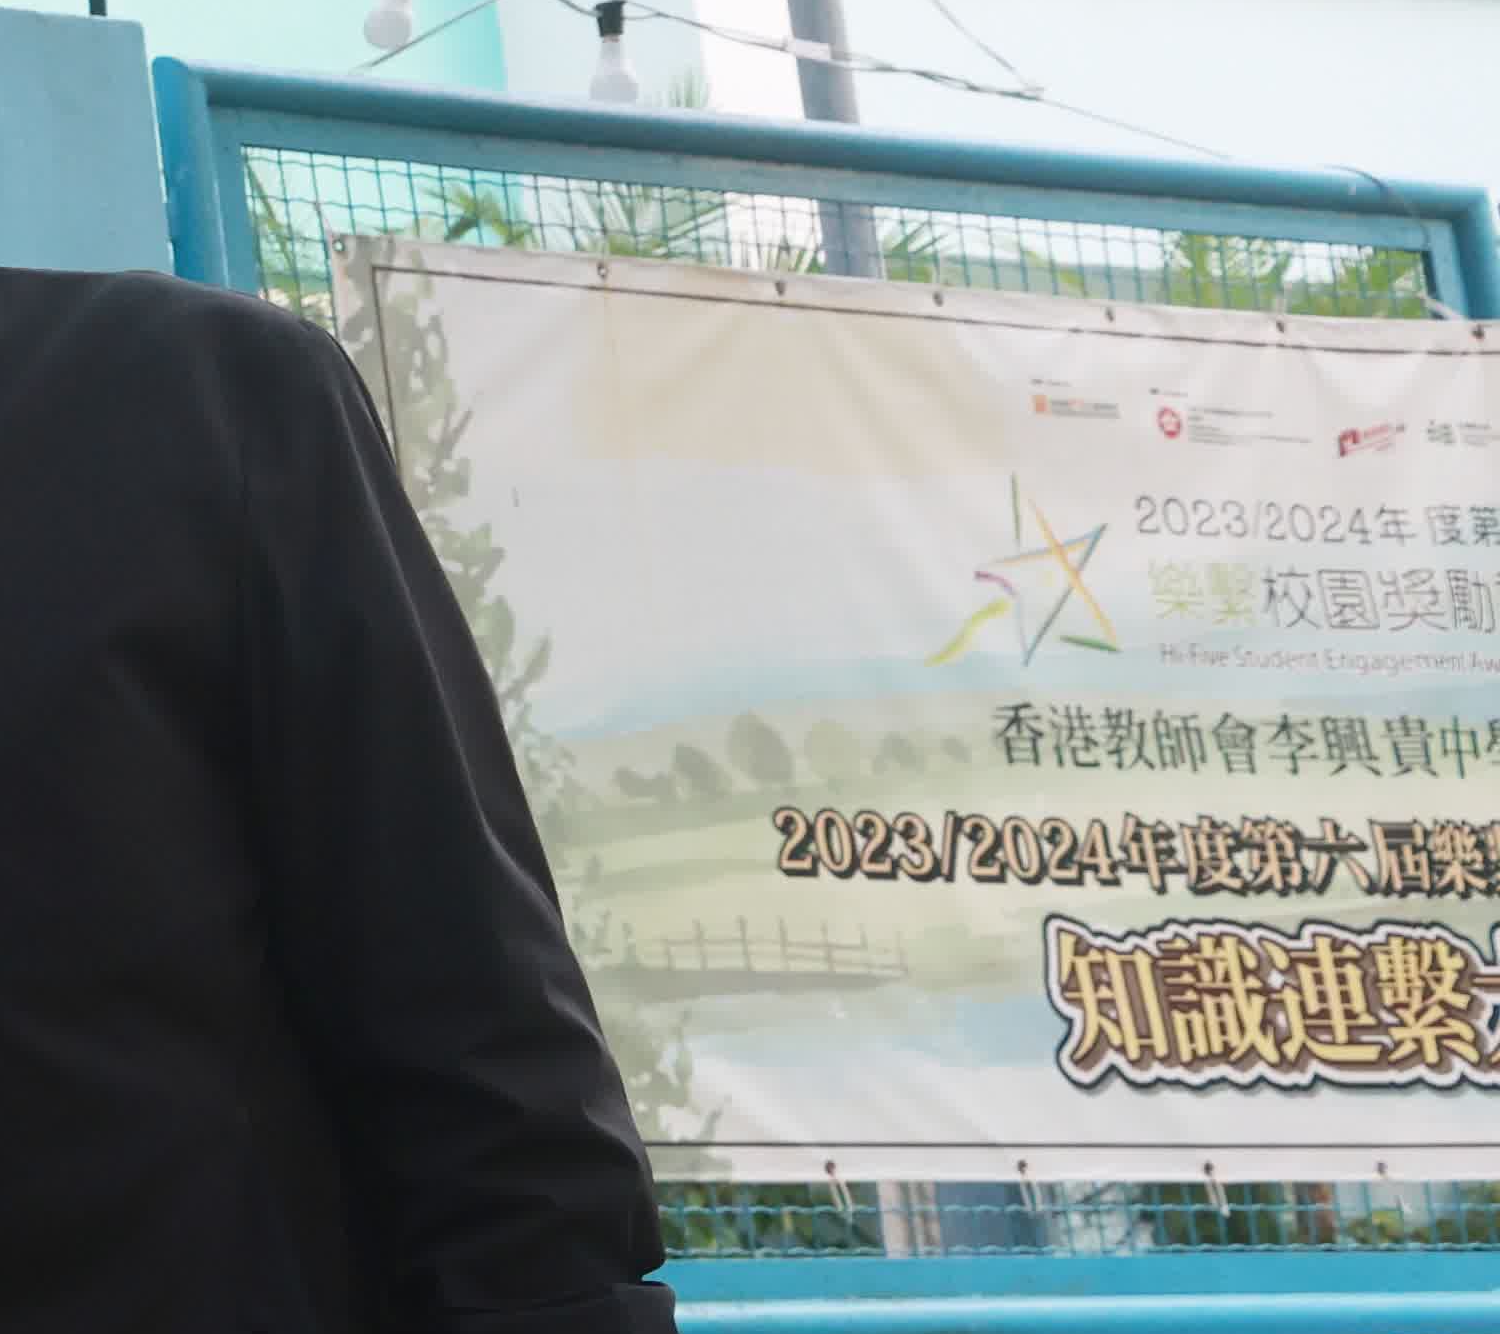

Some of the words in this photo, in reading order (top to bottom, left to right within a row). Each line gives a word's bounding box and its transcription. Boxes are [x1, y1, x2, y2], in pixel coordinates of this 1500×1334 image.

[1150, 562, 1500, 634] 樂繫校園獎勵
